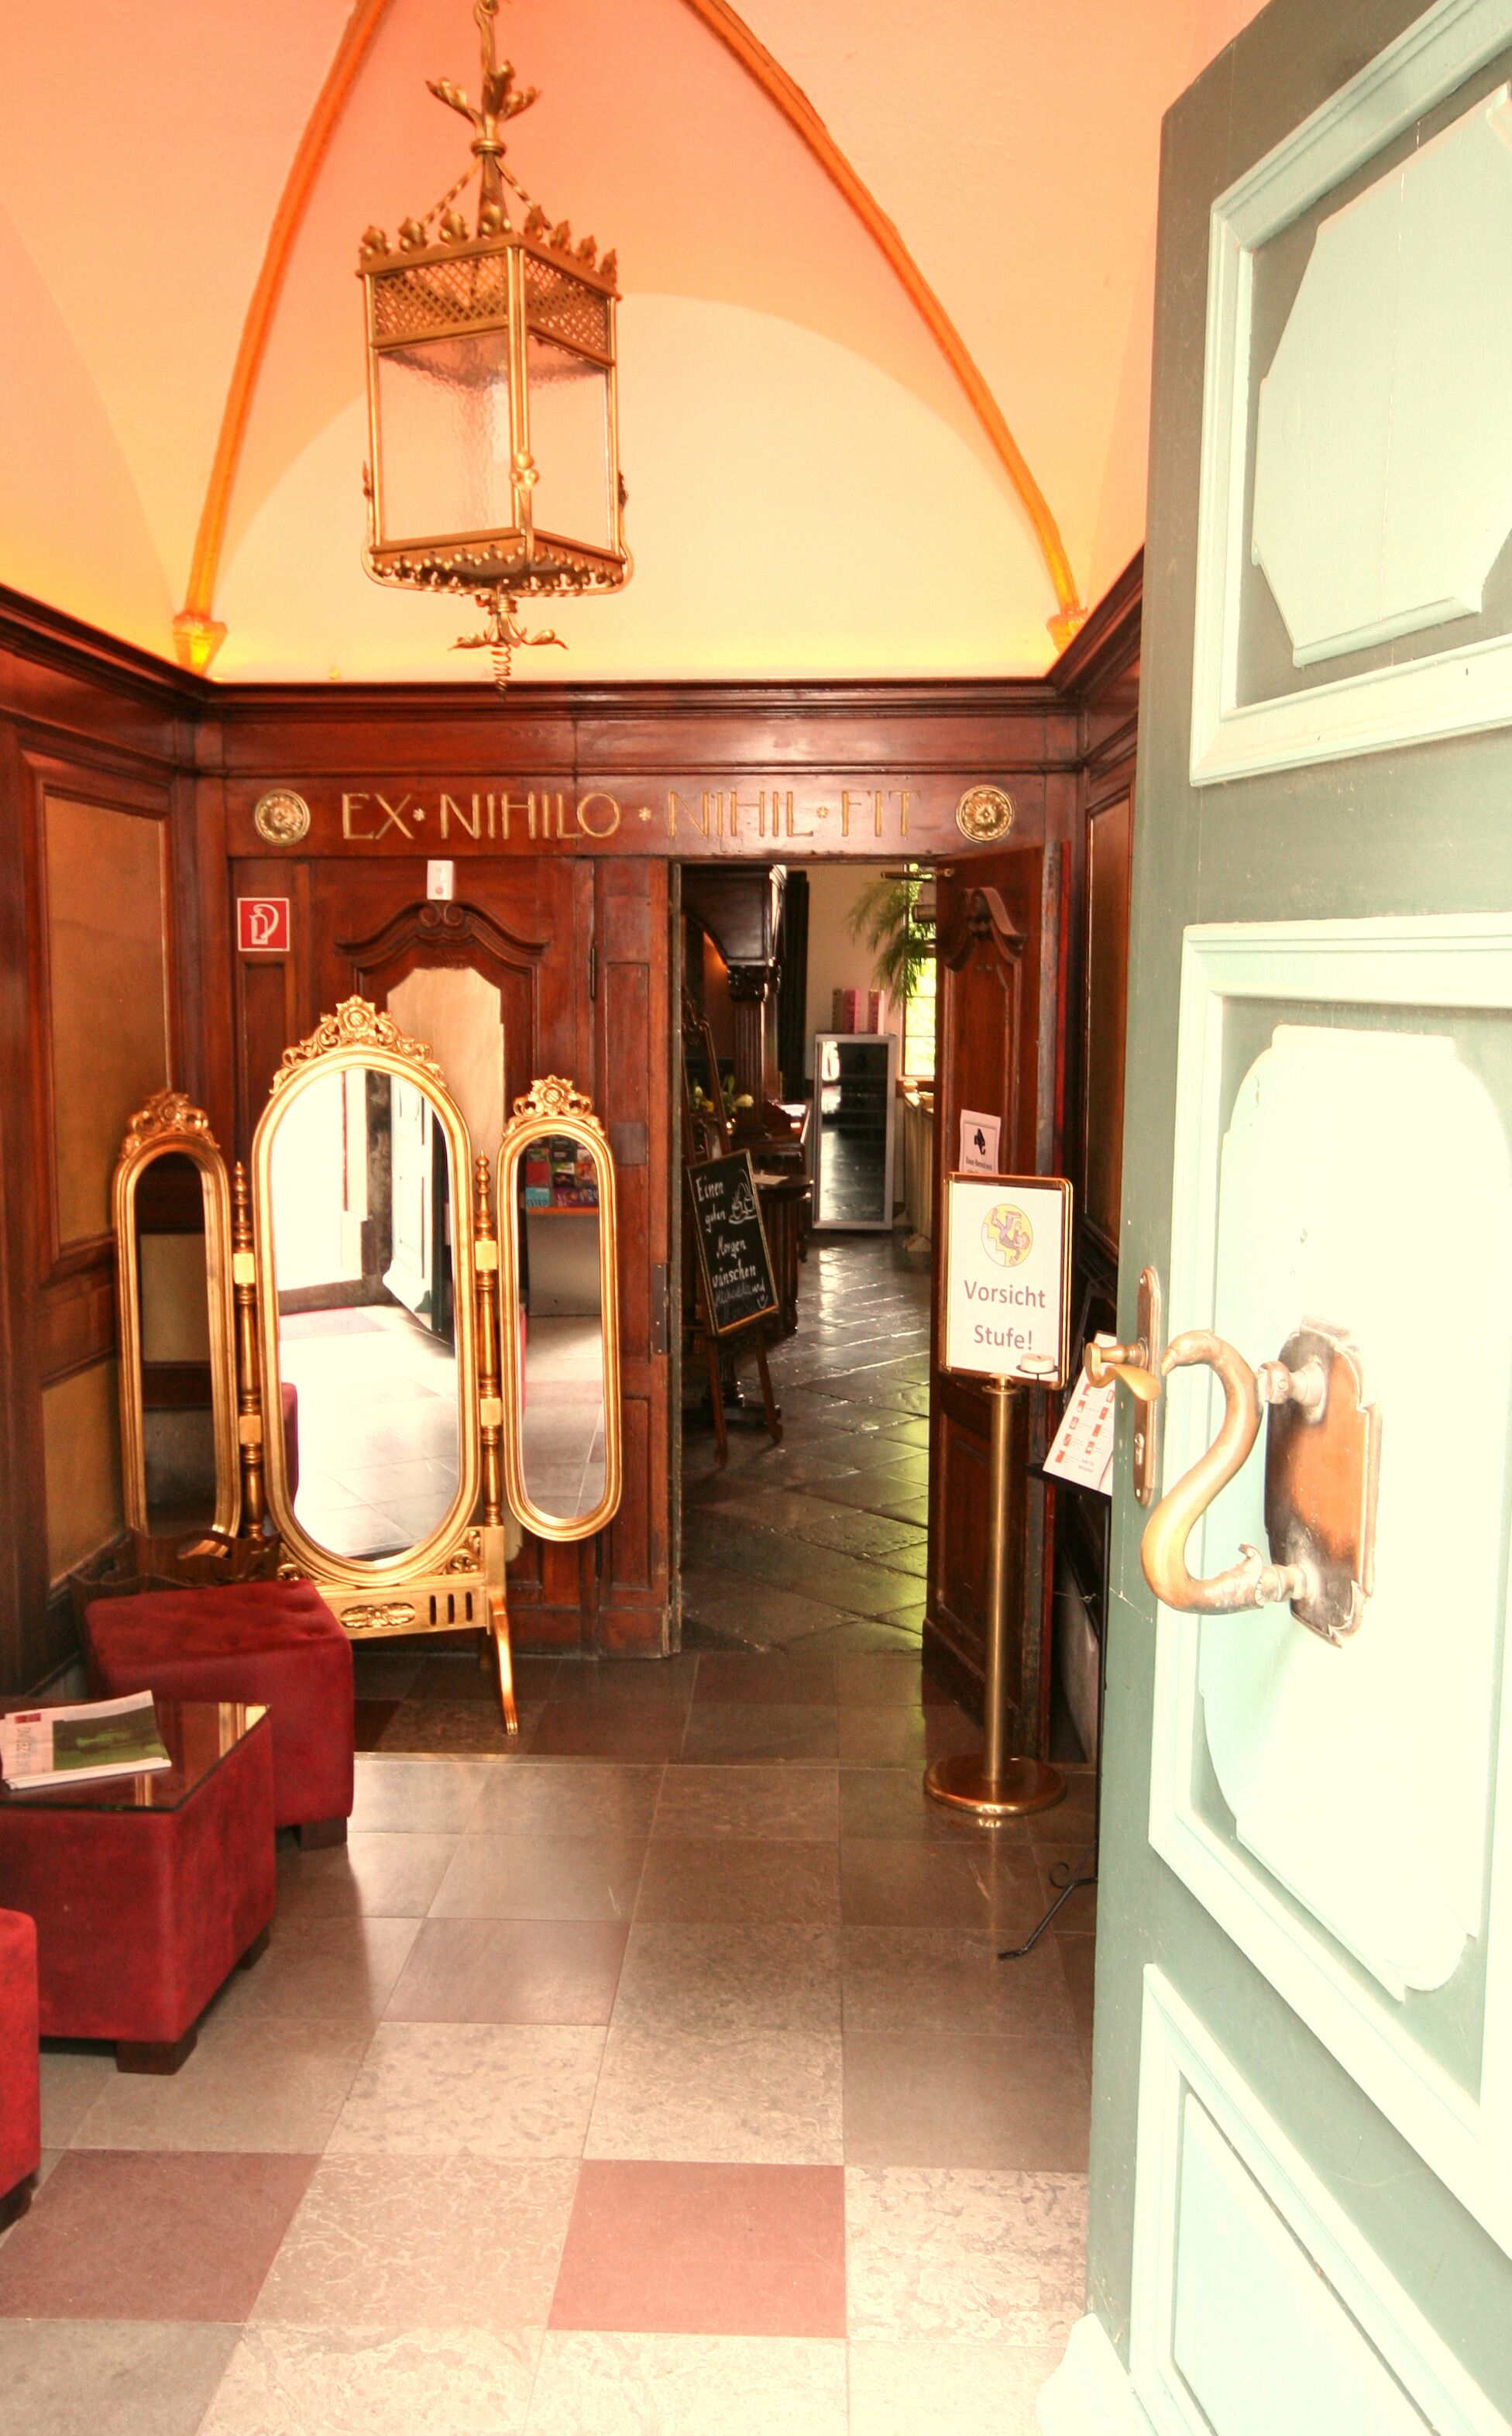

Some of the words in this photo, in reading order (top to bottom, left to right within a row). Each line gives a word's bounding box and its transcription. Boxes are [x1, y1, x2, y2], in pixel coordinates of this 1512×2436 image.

[342, 792, 414, 840] EX
[439, 791, 621, 840] NIHILO
[668, 790, 814, 838] NIHIL
[840, 790, 922, 838] FIT
[964, 1279, 1046, 1309] Vorsicht
[974, 1324, 1033, 1350] Stufe!
